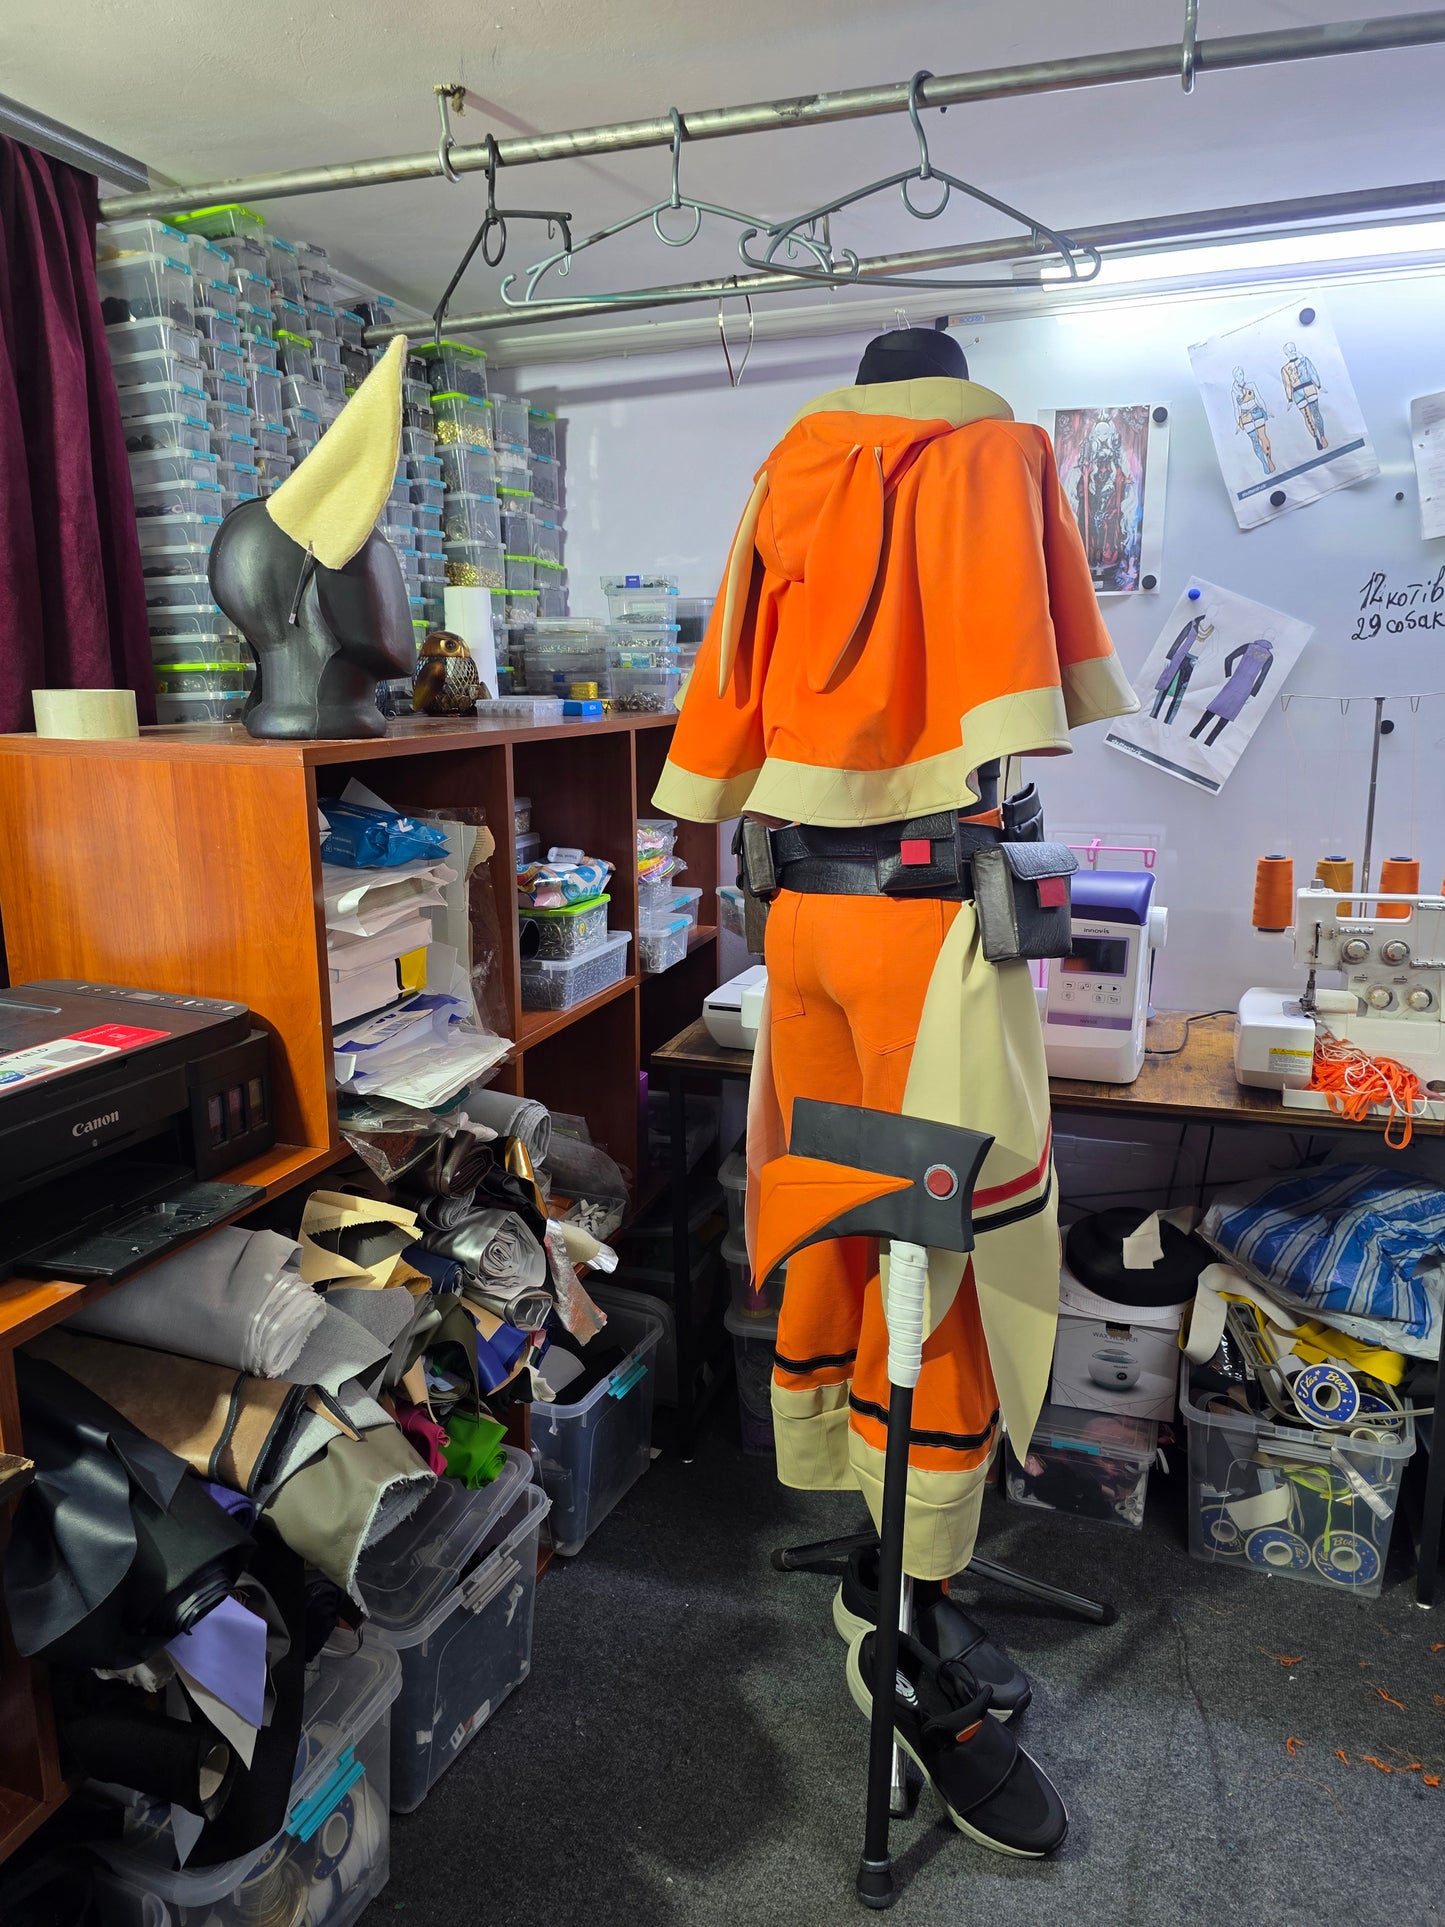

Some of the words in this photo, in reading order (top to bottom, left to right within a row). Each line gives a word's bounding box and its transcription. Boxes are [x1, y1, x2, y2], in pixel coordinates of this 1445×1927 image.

[1359, 572, 1386, 611] 12
[1351, 613, 1382, 640] 29
[1386, 609, 1445, 634] собак
[72, 1110, 119, 1137] Canon
